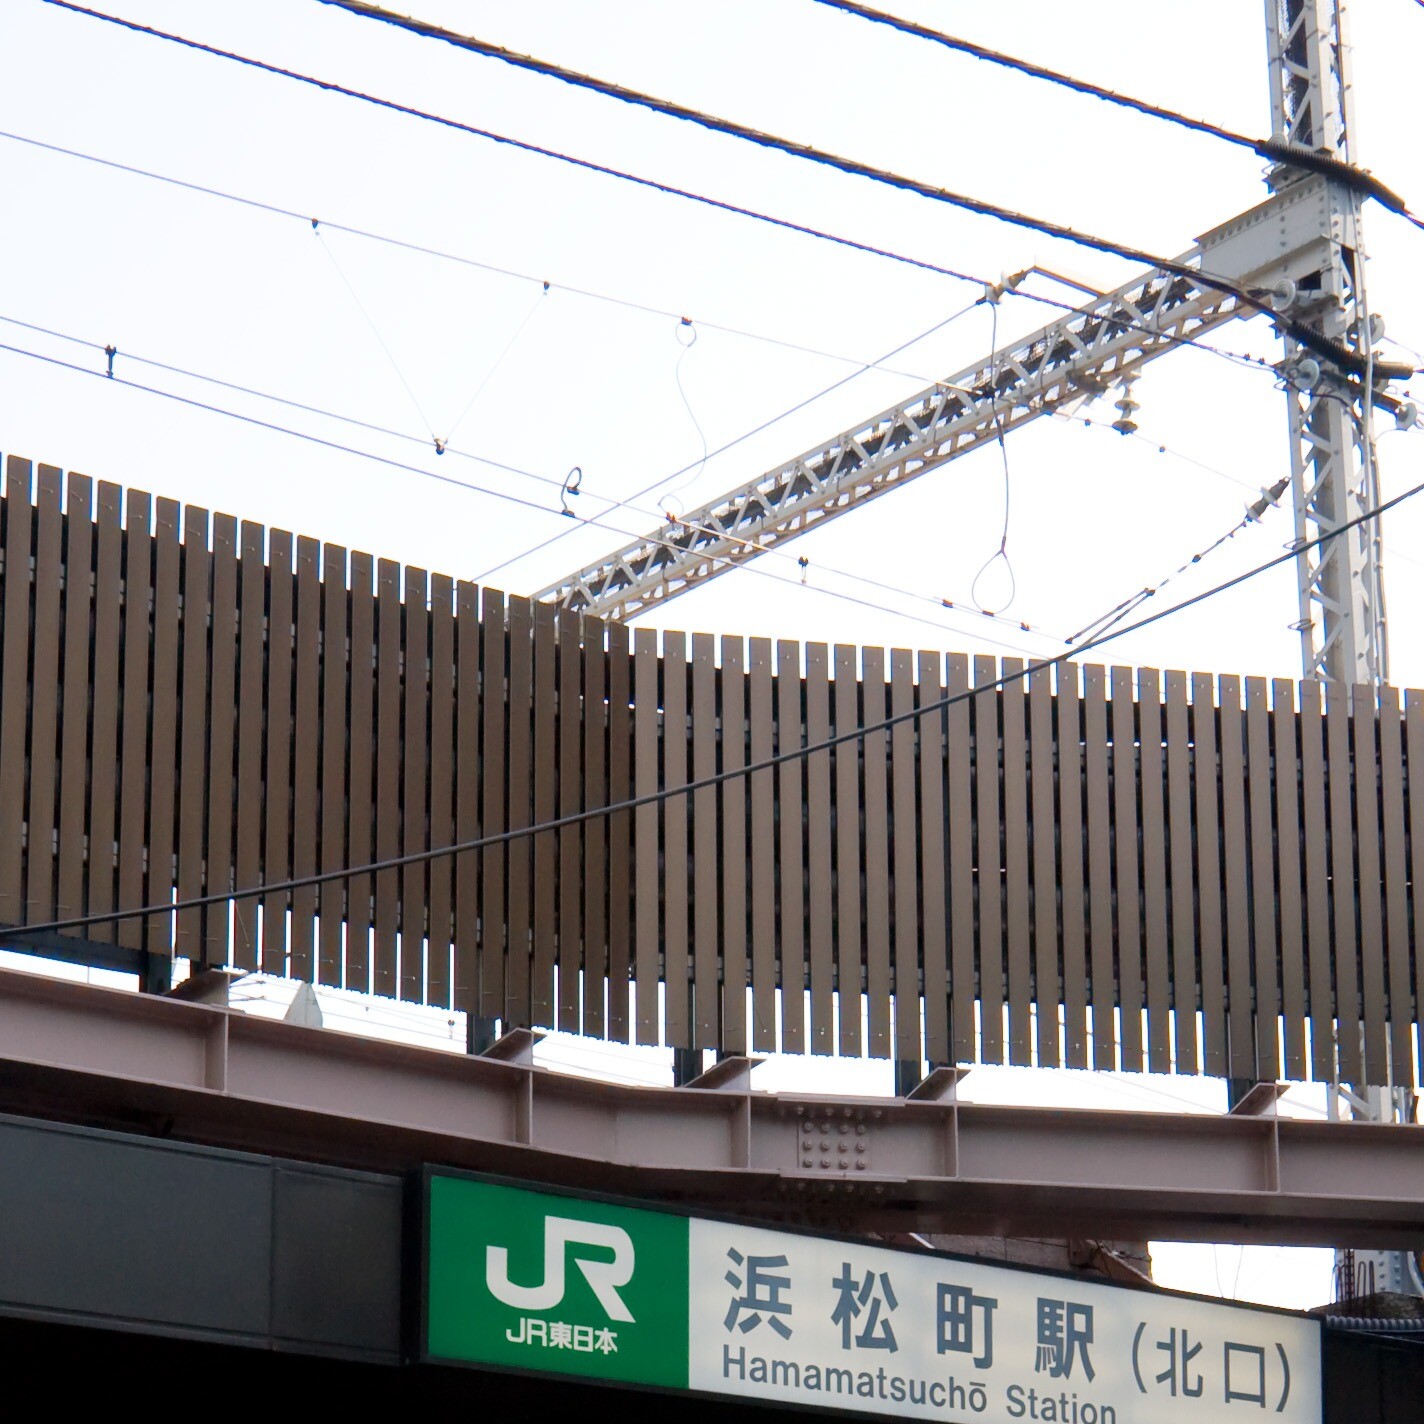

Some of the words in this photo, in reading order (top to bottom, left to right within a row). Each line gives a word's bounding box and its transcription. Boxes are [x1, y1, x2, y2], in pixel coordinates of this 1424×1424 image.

[486, 1215, 636, 1324] JR
[506, 1318, 619, 1357] JR東日本
[722, 1344, 989, 1415] Hamamatsuchō
